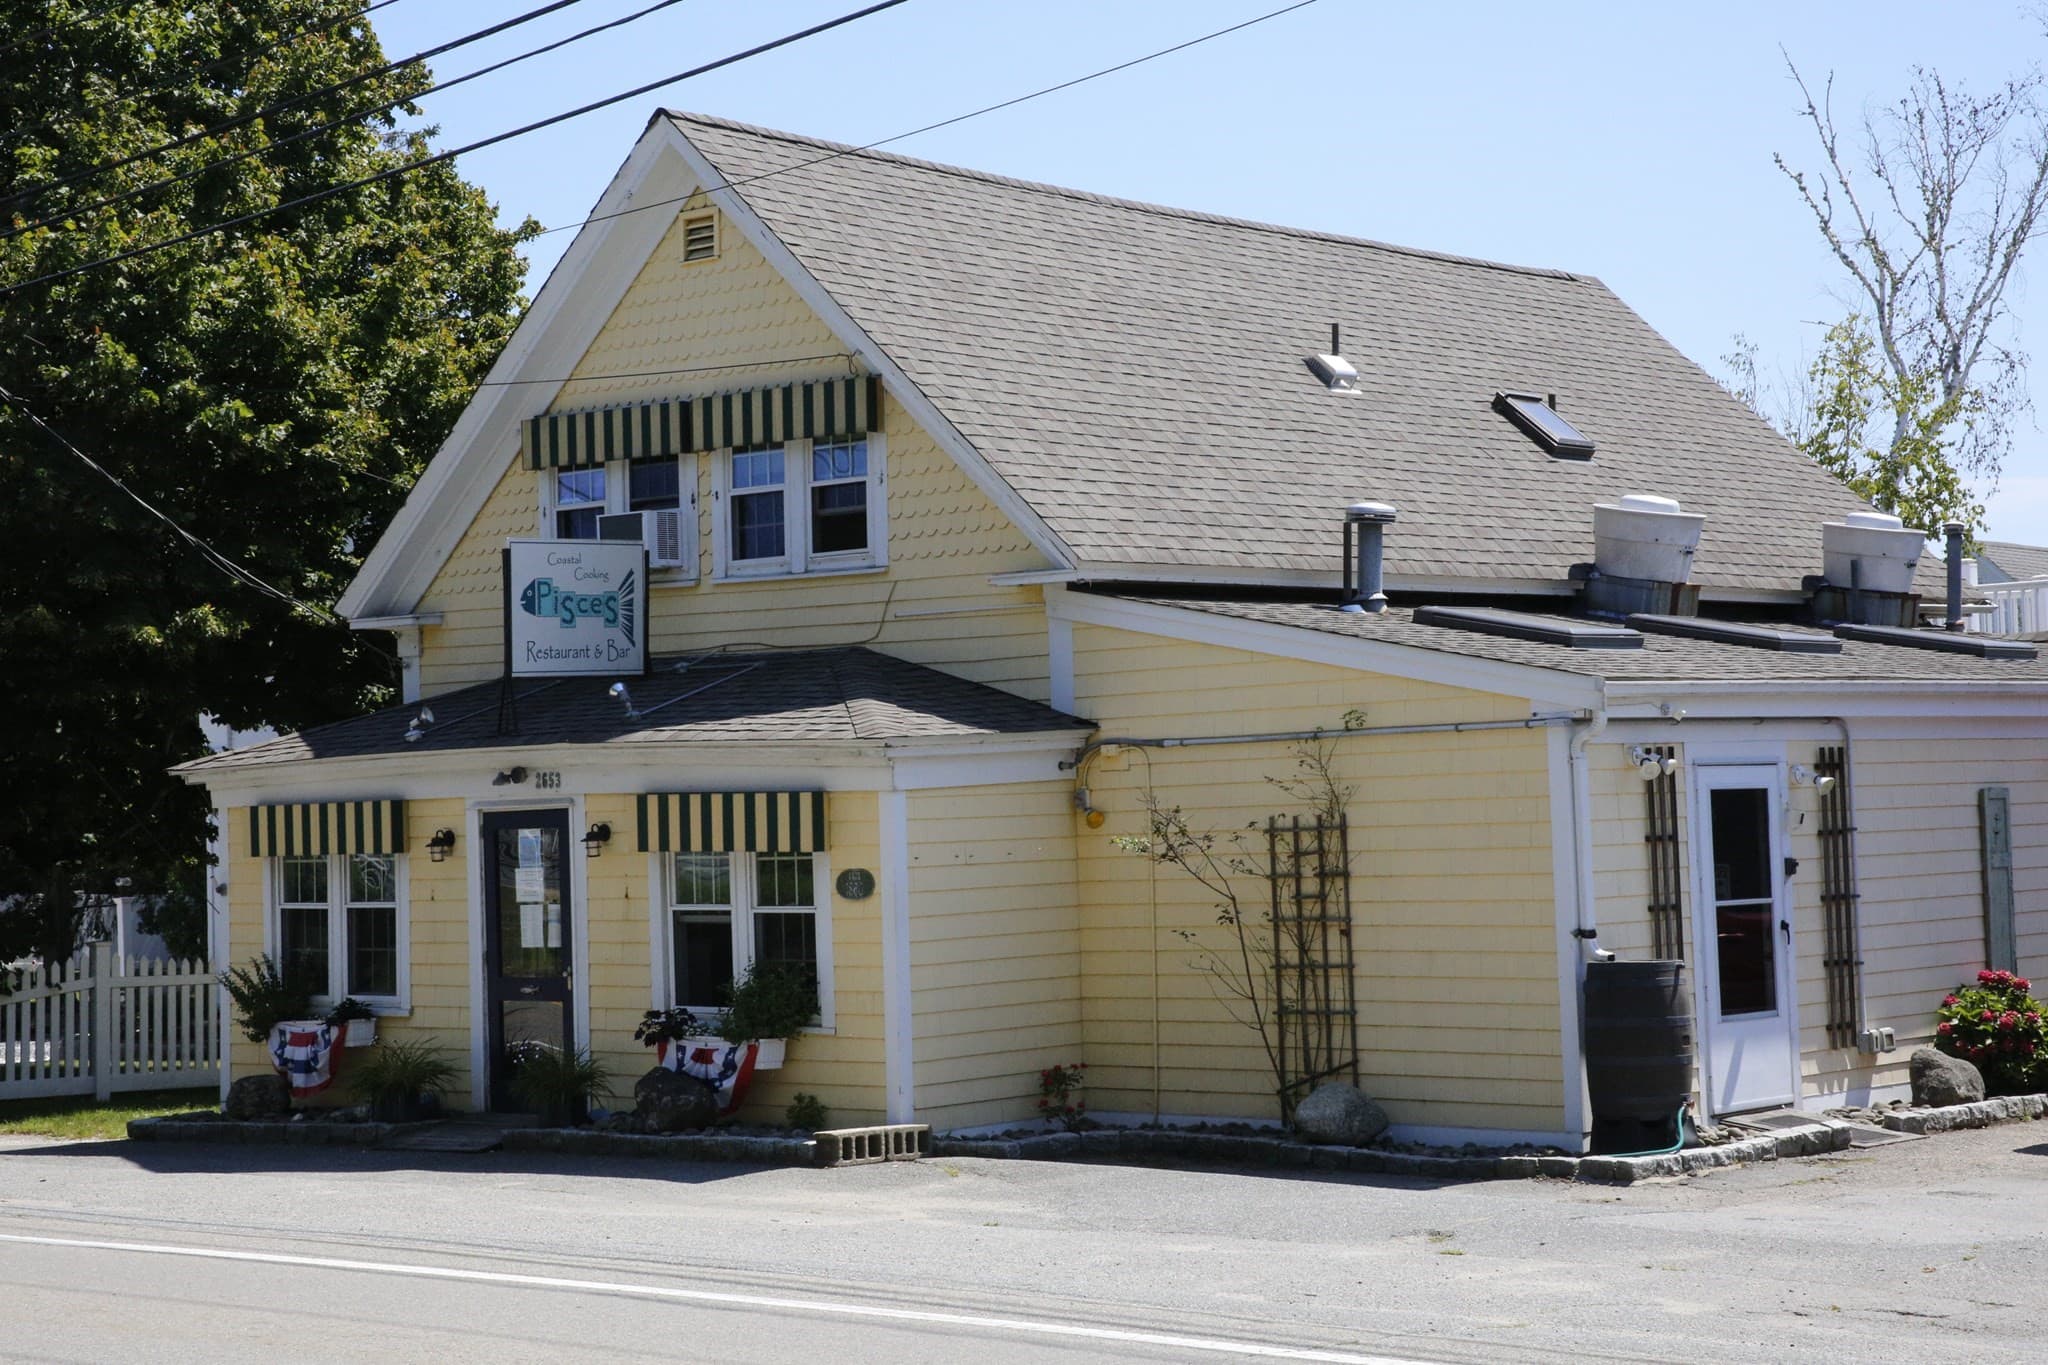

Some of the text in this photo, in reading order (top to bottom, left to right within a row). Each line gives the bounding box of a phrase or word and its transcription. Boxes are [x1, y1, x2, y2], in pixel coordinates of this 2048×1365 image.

[547, 552, 582, 566] Coastal
[574, 567, 610, 583] Cooking
[526, 638, 631, 663] Restaurant & Bar
[536, 772, 561, 789] 2653
